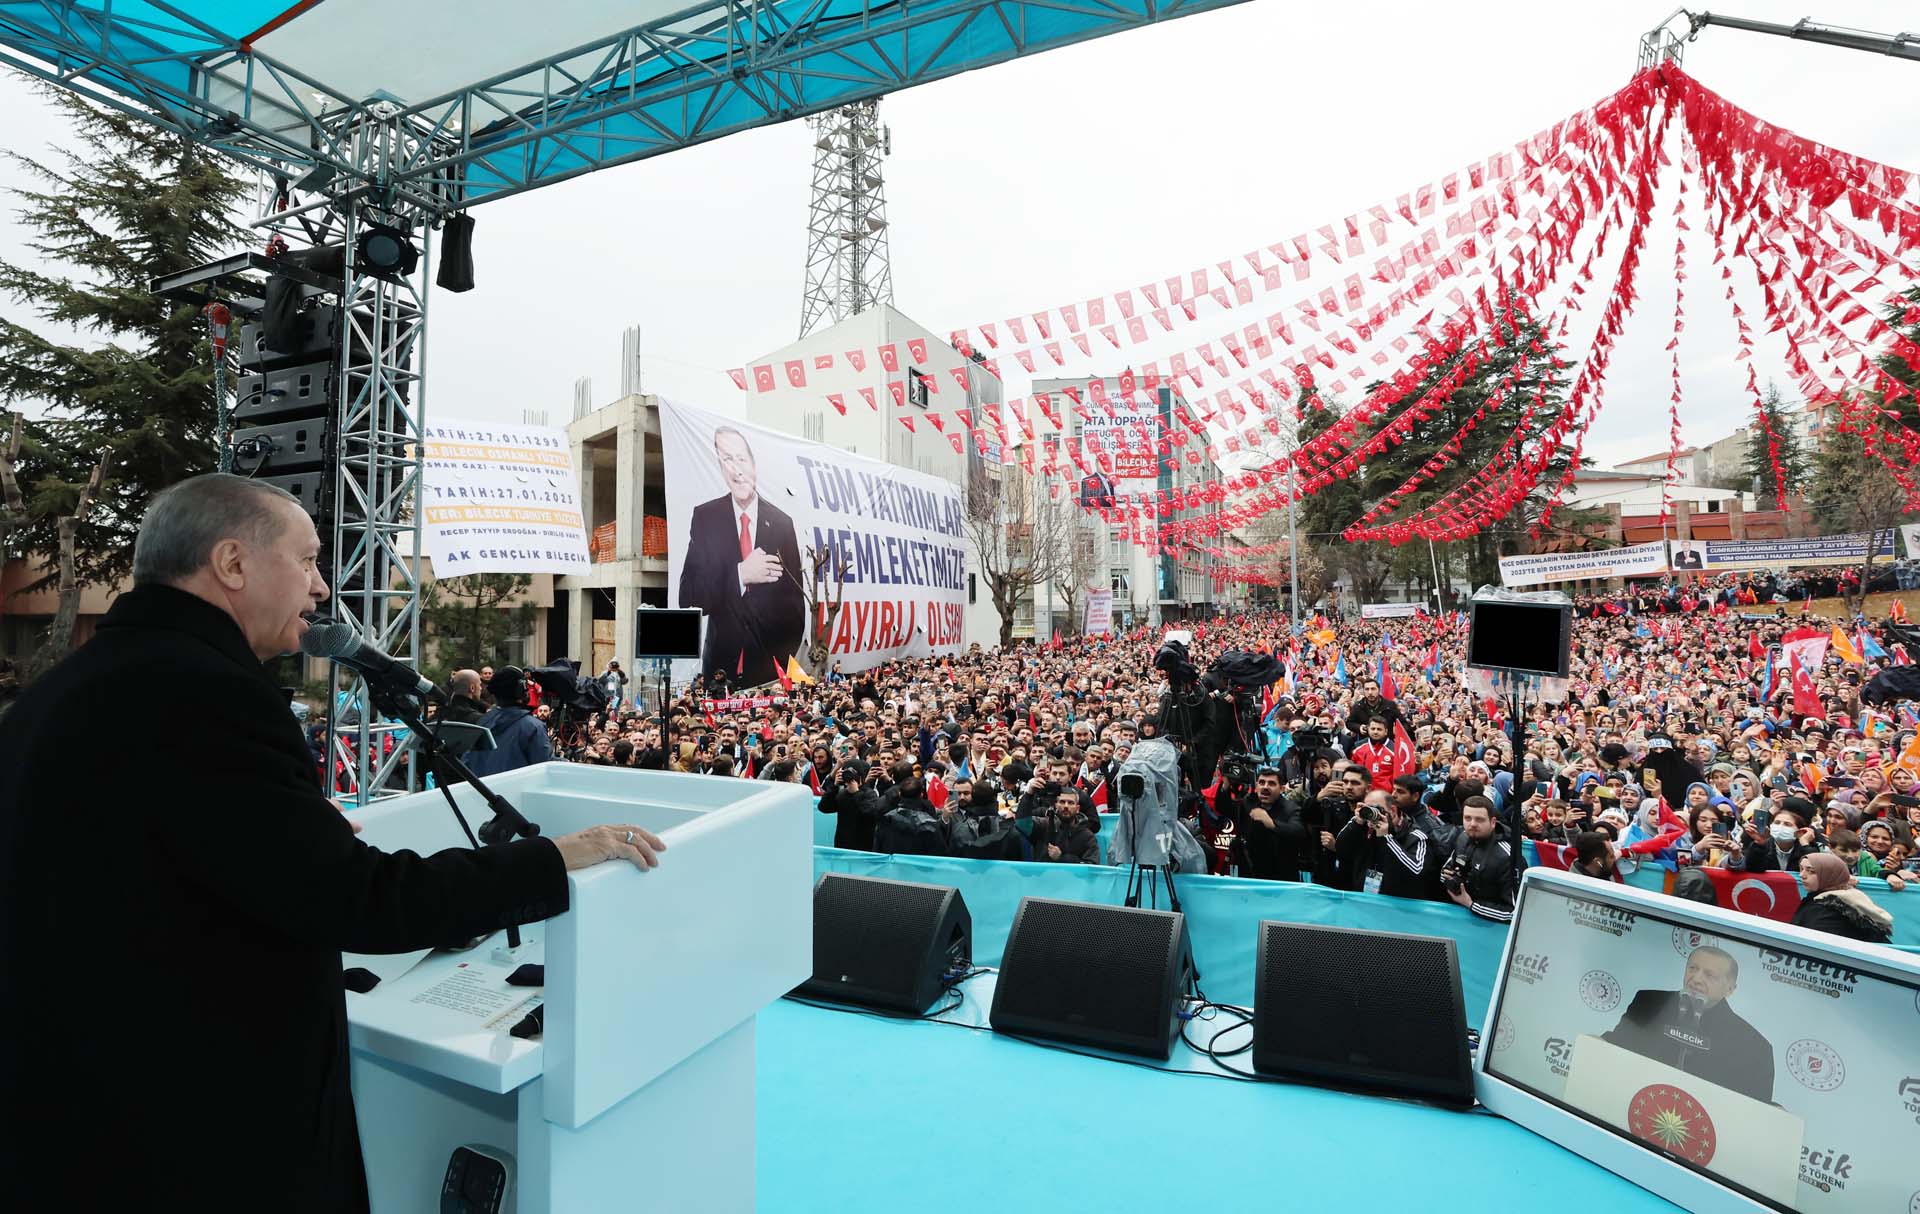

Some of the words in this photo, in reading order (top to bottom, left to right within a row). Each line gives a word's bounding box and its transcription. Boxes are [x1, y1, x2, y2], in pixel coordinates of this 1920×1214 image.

[425, 427, 560, 448] ARİH:27.01.1299
[796, 455, 862, 516] TÜM
[859, 471, 964, 538] YATIRIMLAR
[447, 550, 471, 562] AK
[479, 549, 541, 561] GENÇLİK
[546, 550, 587, 563] BİLECİK
[813, 526, 965, 591] MEMLEKETİMİZE
[1549, 564, 1575, 572] DESTAN
[1576, 561, 1596, 569] DAHA
[927, 602, 964, 648] OLSUN
[1762, 963, 1788, 976] TOPLU
[1820, 977, 1854, 994] TÖRENİ
[1545, 1055, 1566, 1069] TOPLU
[1809, 1166, 1845, 1190] TÖRENİ
